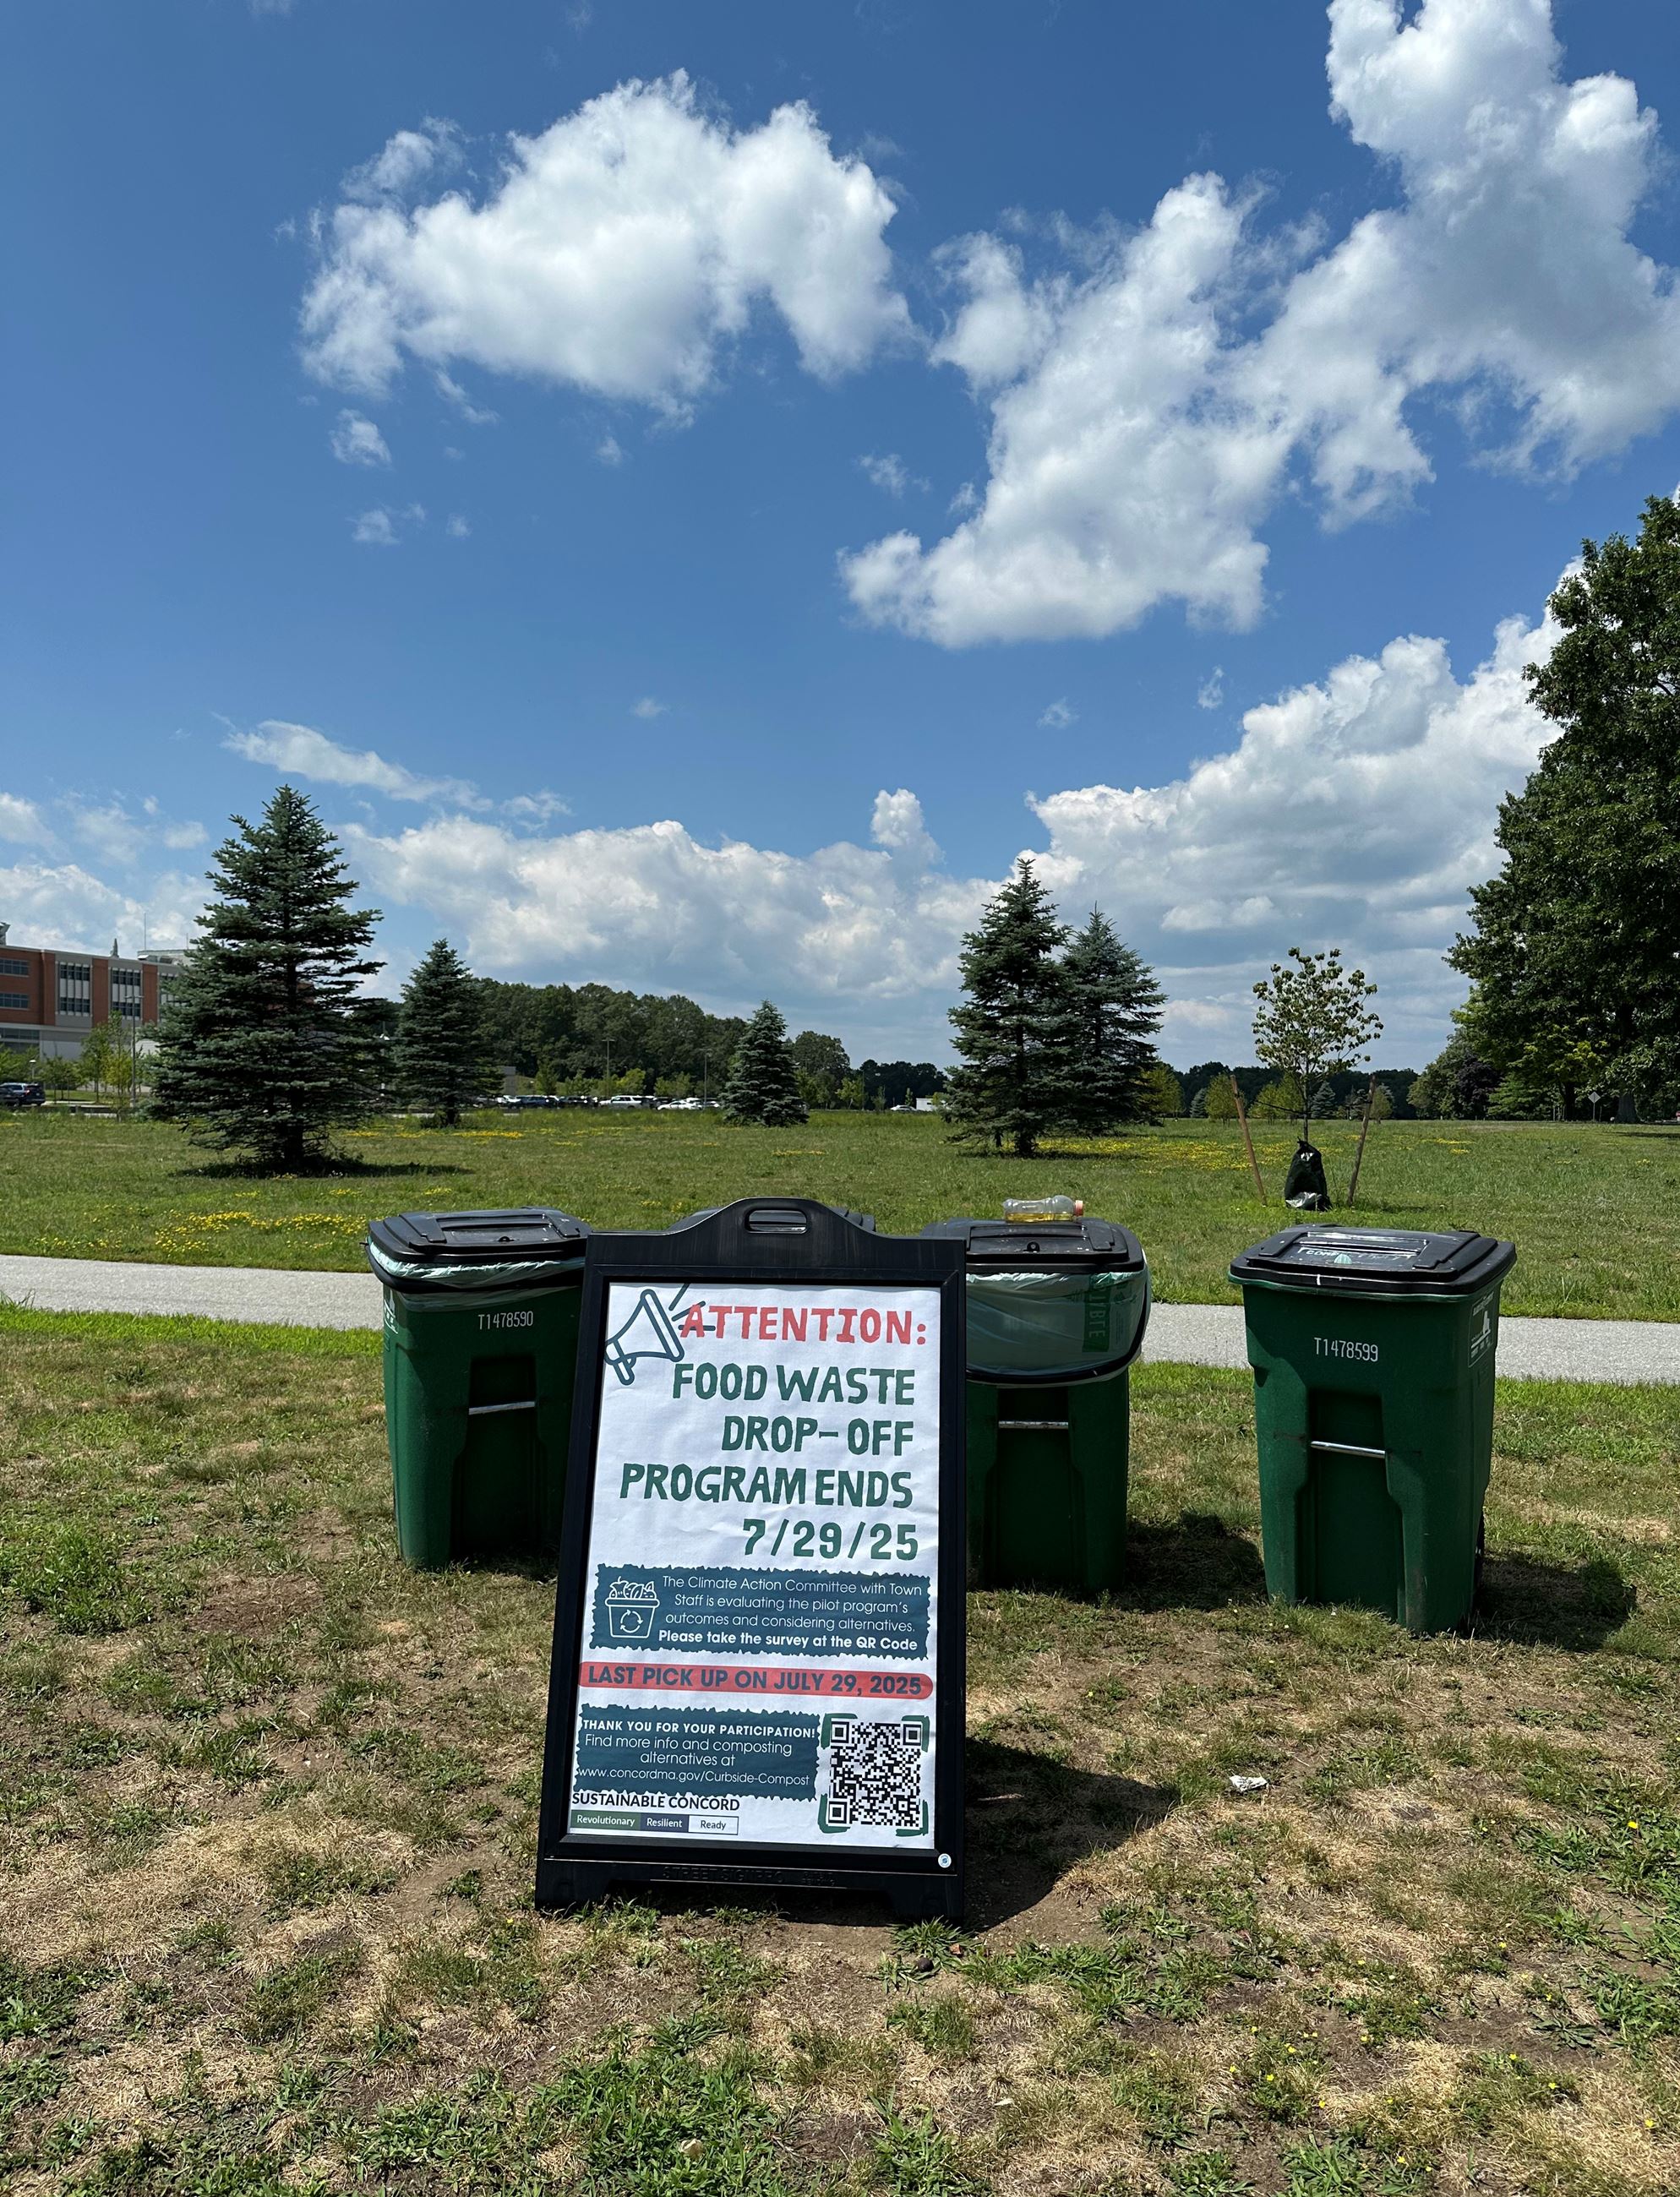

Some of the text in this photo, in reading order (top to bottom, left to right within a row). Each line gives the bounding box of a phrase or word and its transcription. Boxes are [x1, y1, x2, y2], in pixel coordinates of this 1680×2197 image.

[478, 1311, 534, 1330] T1478590
[679, 1305, 926, 1344] ATTENTION:
[1314, 1338, 1378, 1362] T1478599
[673, 1363, 915, 1405] FOOD WASTE
[619, 1464, 913, 1508] PROGRAM ENDS
[743, 1518, 918, 1561] 7/29/25
[663, 1575, 922, 1596] The Climate Action Committee with Town
[674, 1594, 908, 1616] Staff is evaluating the pilot program's
[665, 1613, 915, 1633] outcomes and considering alternatives.
[658, 1629, 918, 1650] Please take the survey at the QR Code
[588, 1665, 922, 1697] LAST PICK UP ON JULY 29, 2025
[583, 1720, 815, 1738] THANK YOU FOR YOUR PARTICIPATION!
[585, 1734, 793, 1757] Find more info and composting
[640, 1752, 736, 1766] alternatives at
[577, 1767, 810, 1786] www.concordma.gov/Curbside-Compost
[571, 1792, 740, 1811] SUSTAINABLE CONCORD
[576, 1815, 635, 1827] Revolutionary
[646, 1818, 683, 1828] Resilient
[701, 1820, 727, 1830] Ready
